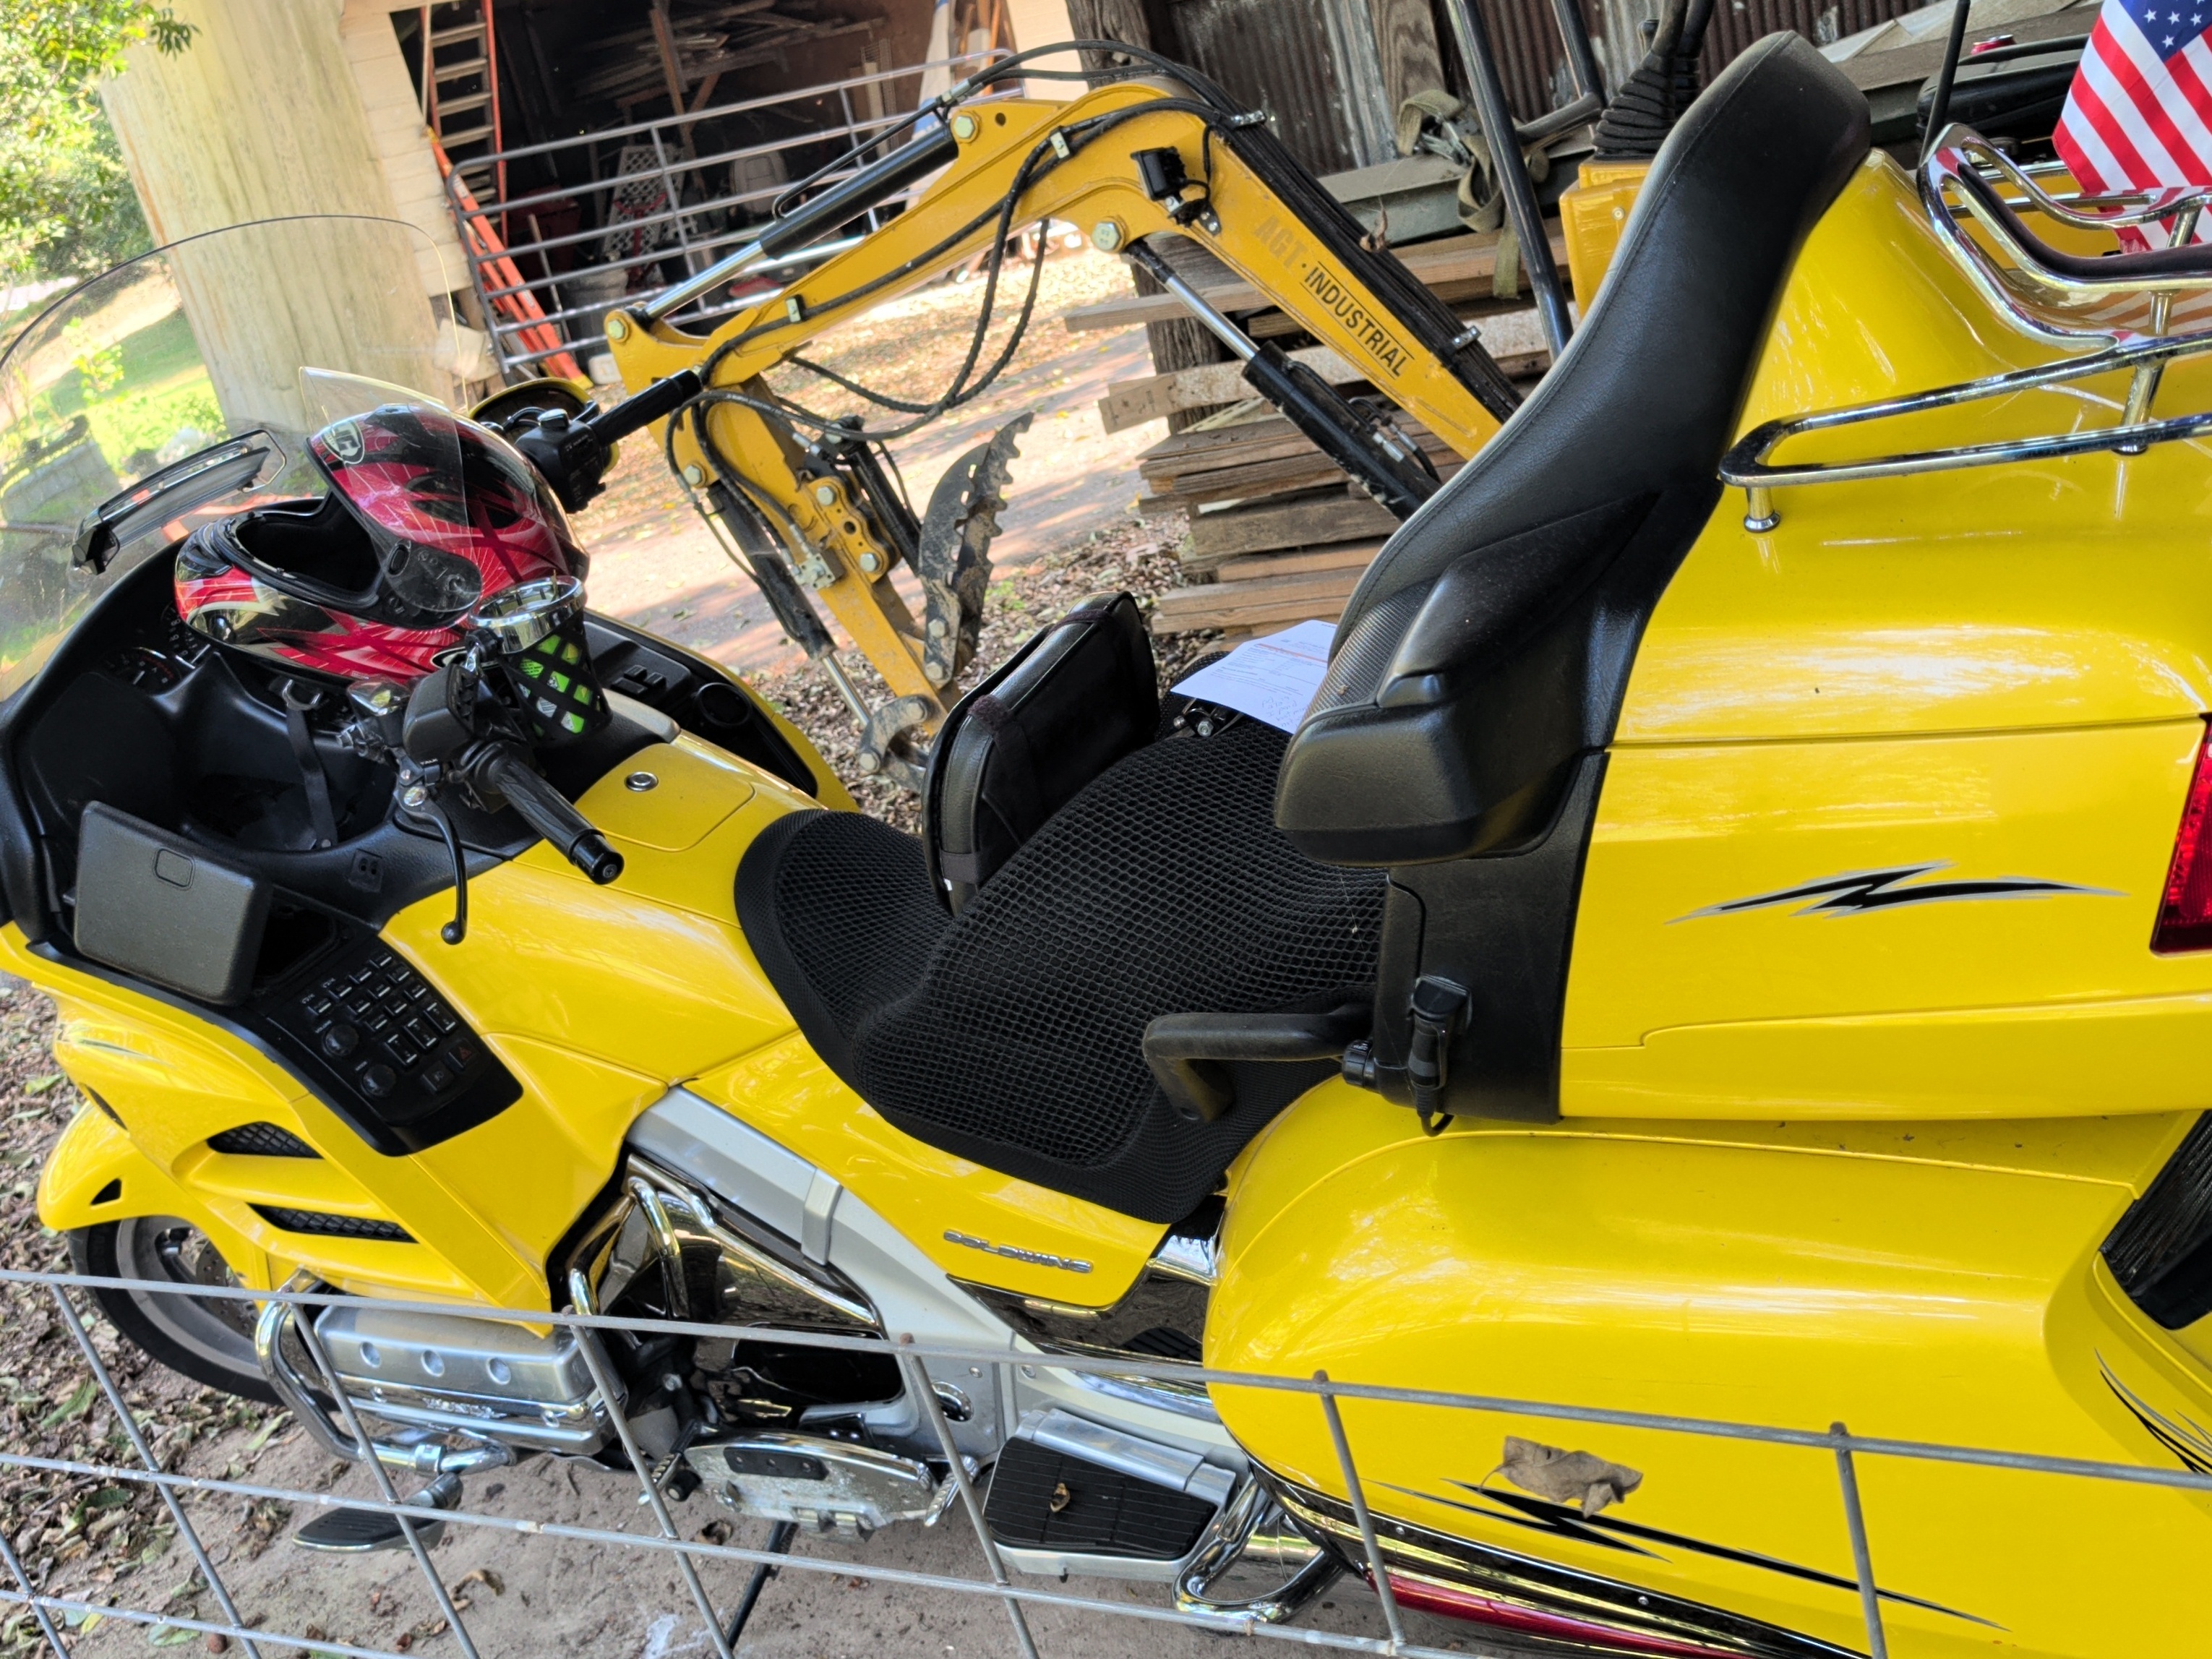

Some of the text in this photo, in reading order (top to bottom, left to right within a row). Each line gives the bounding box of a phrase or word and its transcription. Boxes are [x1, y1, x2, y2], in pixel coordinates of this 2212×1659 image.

[1253, 215, 1409, 377] AGT INDUSTRIAL
[943, 1229, 1093, 1274] GOLDWING
